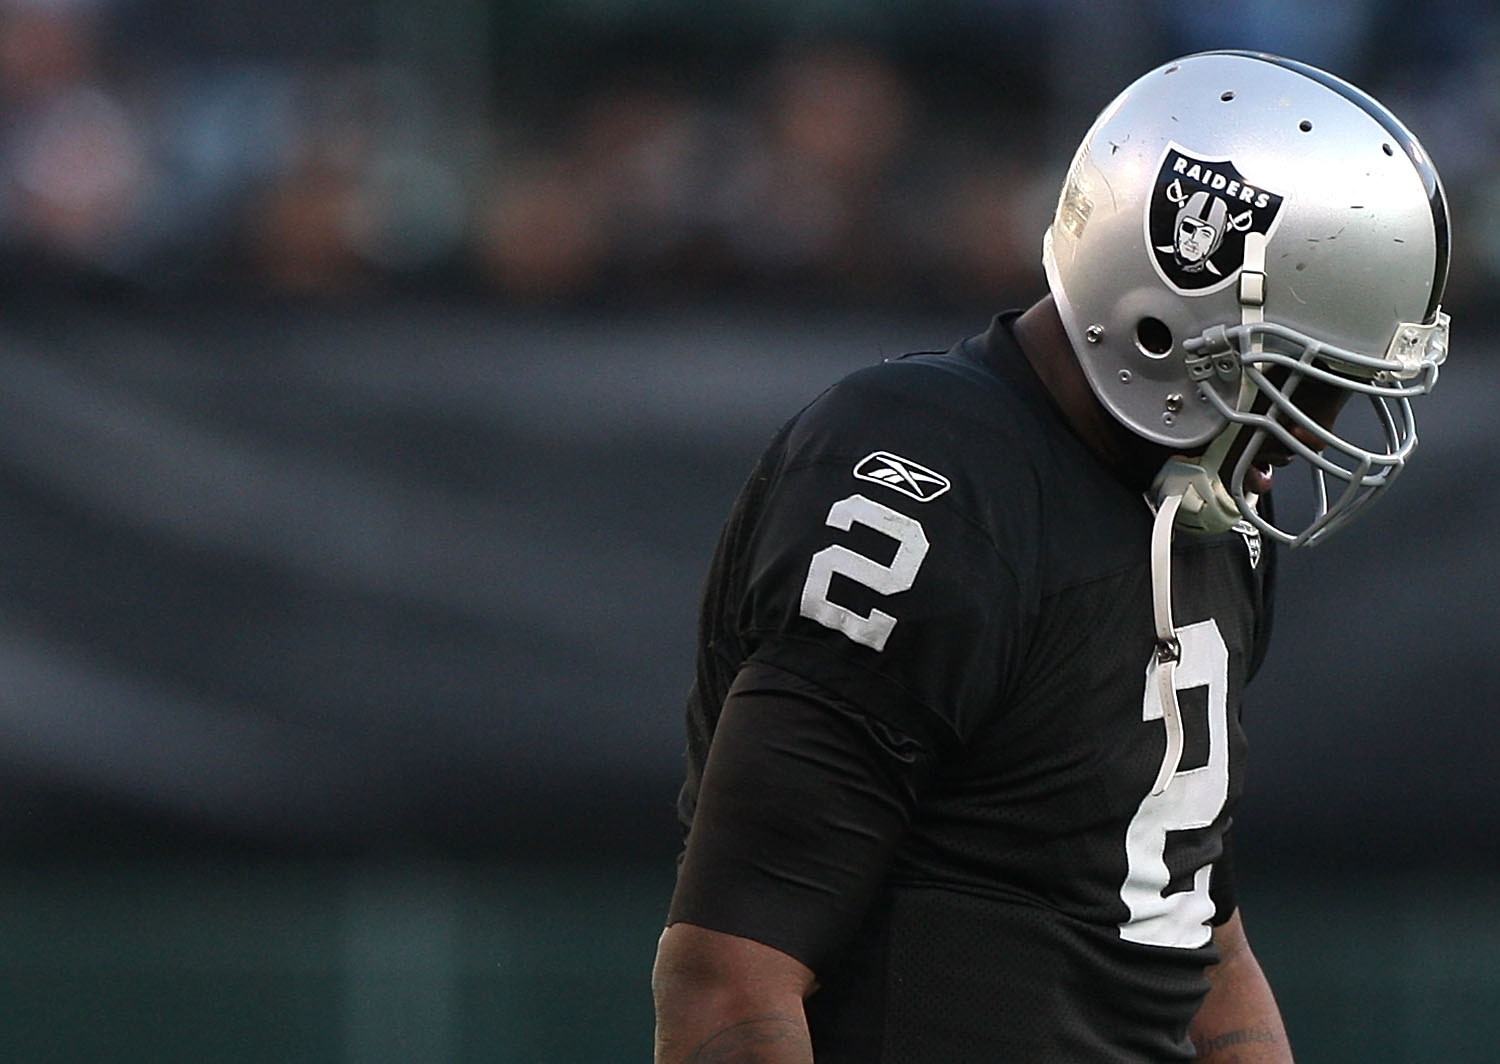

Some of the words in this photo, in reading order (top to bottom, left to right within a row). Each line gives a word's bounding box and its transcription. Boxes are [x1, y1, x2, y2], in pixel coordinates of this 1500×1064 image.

[1173, 157, 1270, 208] RAIDERS
[800, 494, 930, 652] 2
[1119, 618, 1229, 950] 2
